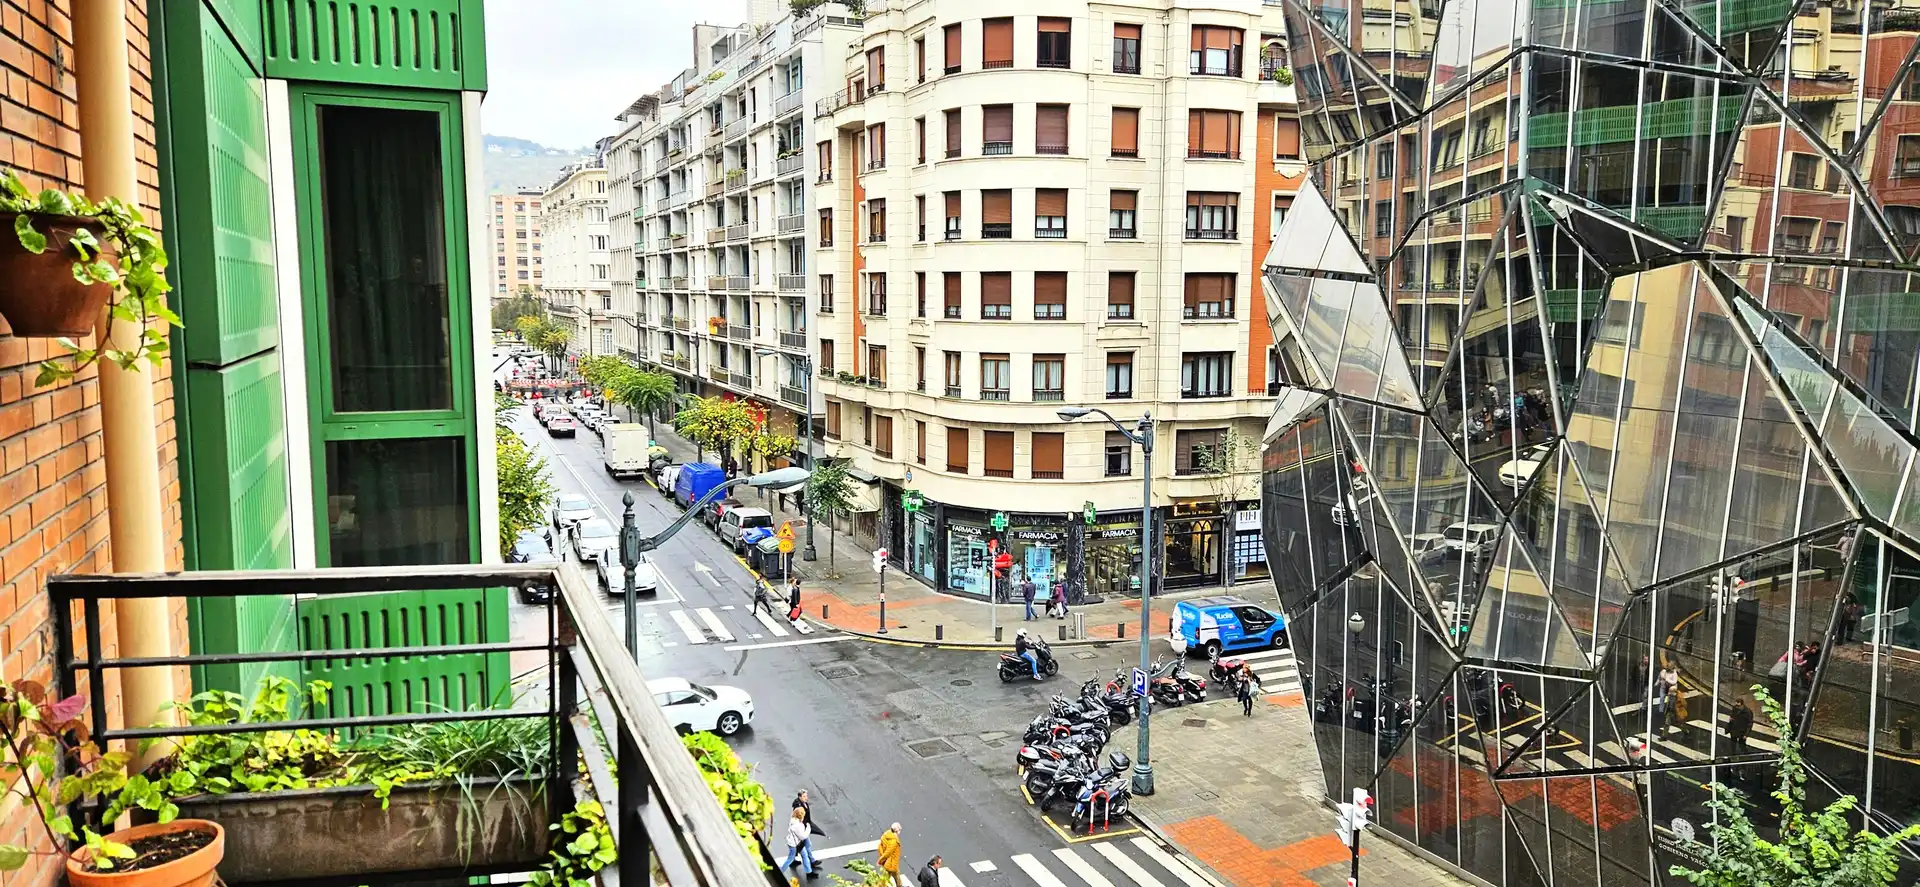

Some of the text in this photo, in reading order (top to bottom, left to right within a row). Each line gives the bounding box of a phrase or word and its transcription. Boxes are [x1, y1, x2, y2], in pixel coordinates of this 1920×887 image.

[952, 524, 982, 536] FARMACIA
[1018, 531, 1058, 540] FARMACIA
[1102, 529, 1137, 538] FARMACIA
[1135, 672, 1144, 691] P
[1657, 835, 1675, 846] EUSKO
[1658, 842, 1710, 869] GOBIERNO VASCO
